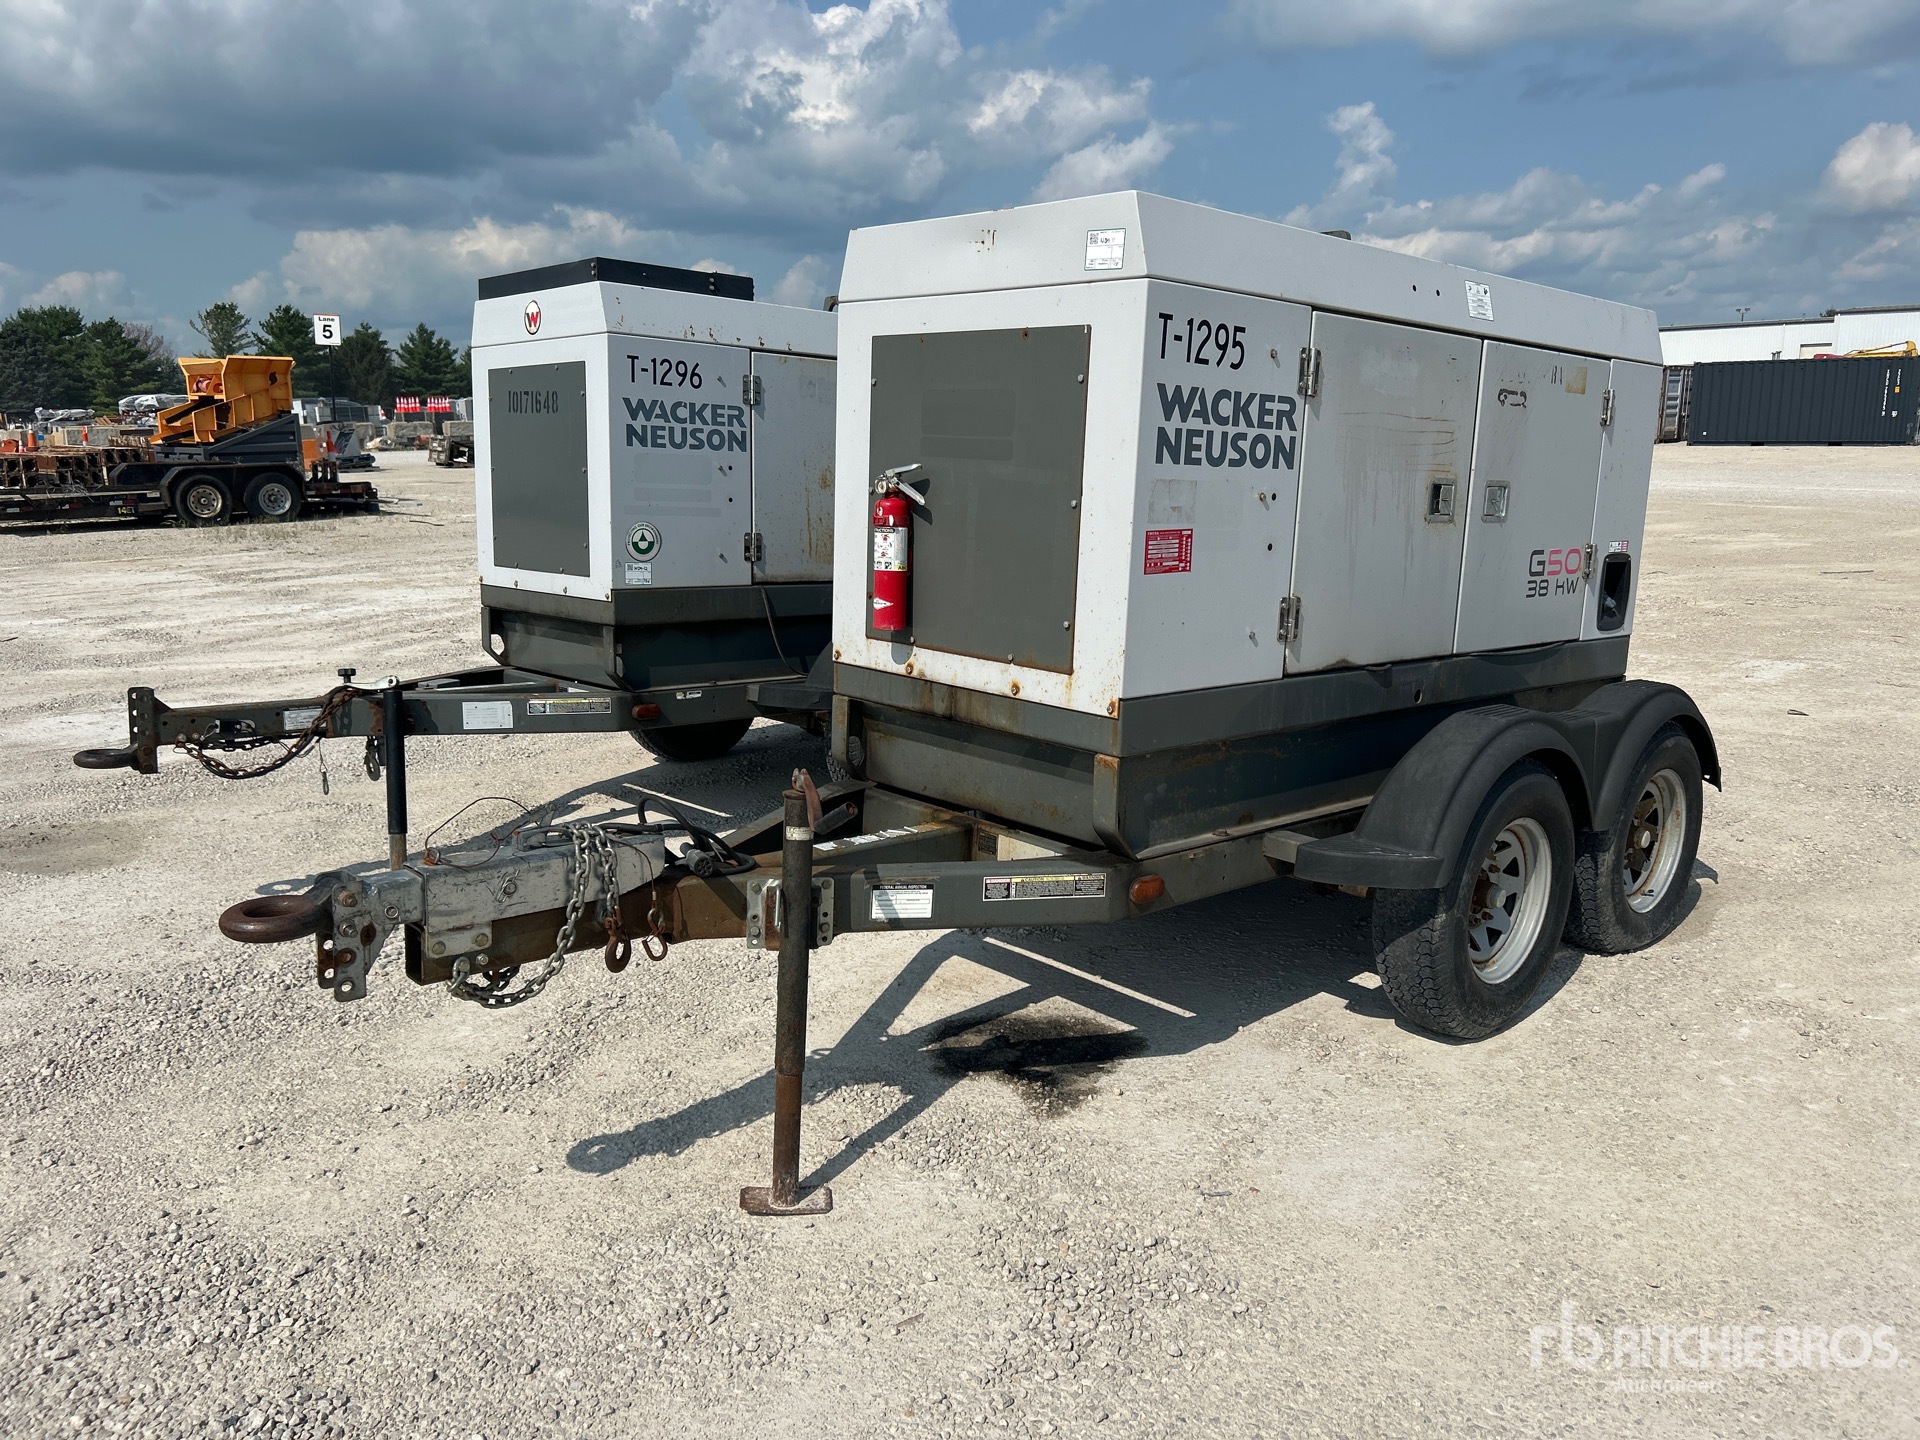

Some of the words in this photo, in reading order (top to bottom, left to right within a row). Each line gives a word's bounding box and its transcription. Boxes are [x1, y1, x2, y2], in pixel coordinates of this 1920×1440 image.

[322, 324, 333, 339] 5
[1158, 312, 1246, 370] T-1295
[626, 354, 703, 389] T-1296
[508, 390, 559, 414] 10171648
[622, 397, 747, 428] WACKER
[1156, 382, 1298, 432] WACKER
[625, 423, 747, 452] NEUSON
[1155, 426, 1297, 470] NEUSON
[1528, 548, 1582, 577] G50
[1526, 579, 1549, 599] 38
